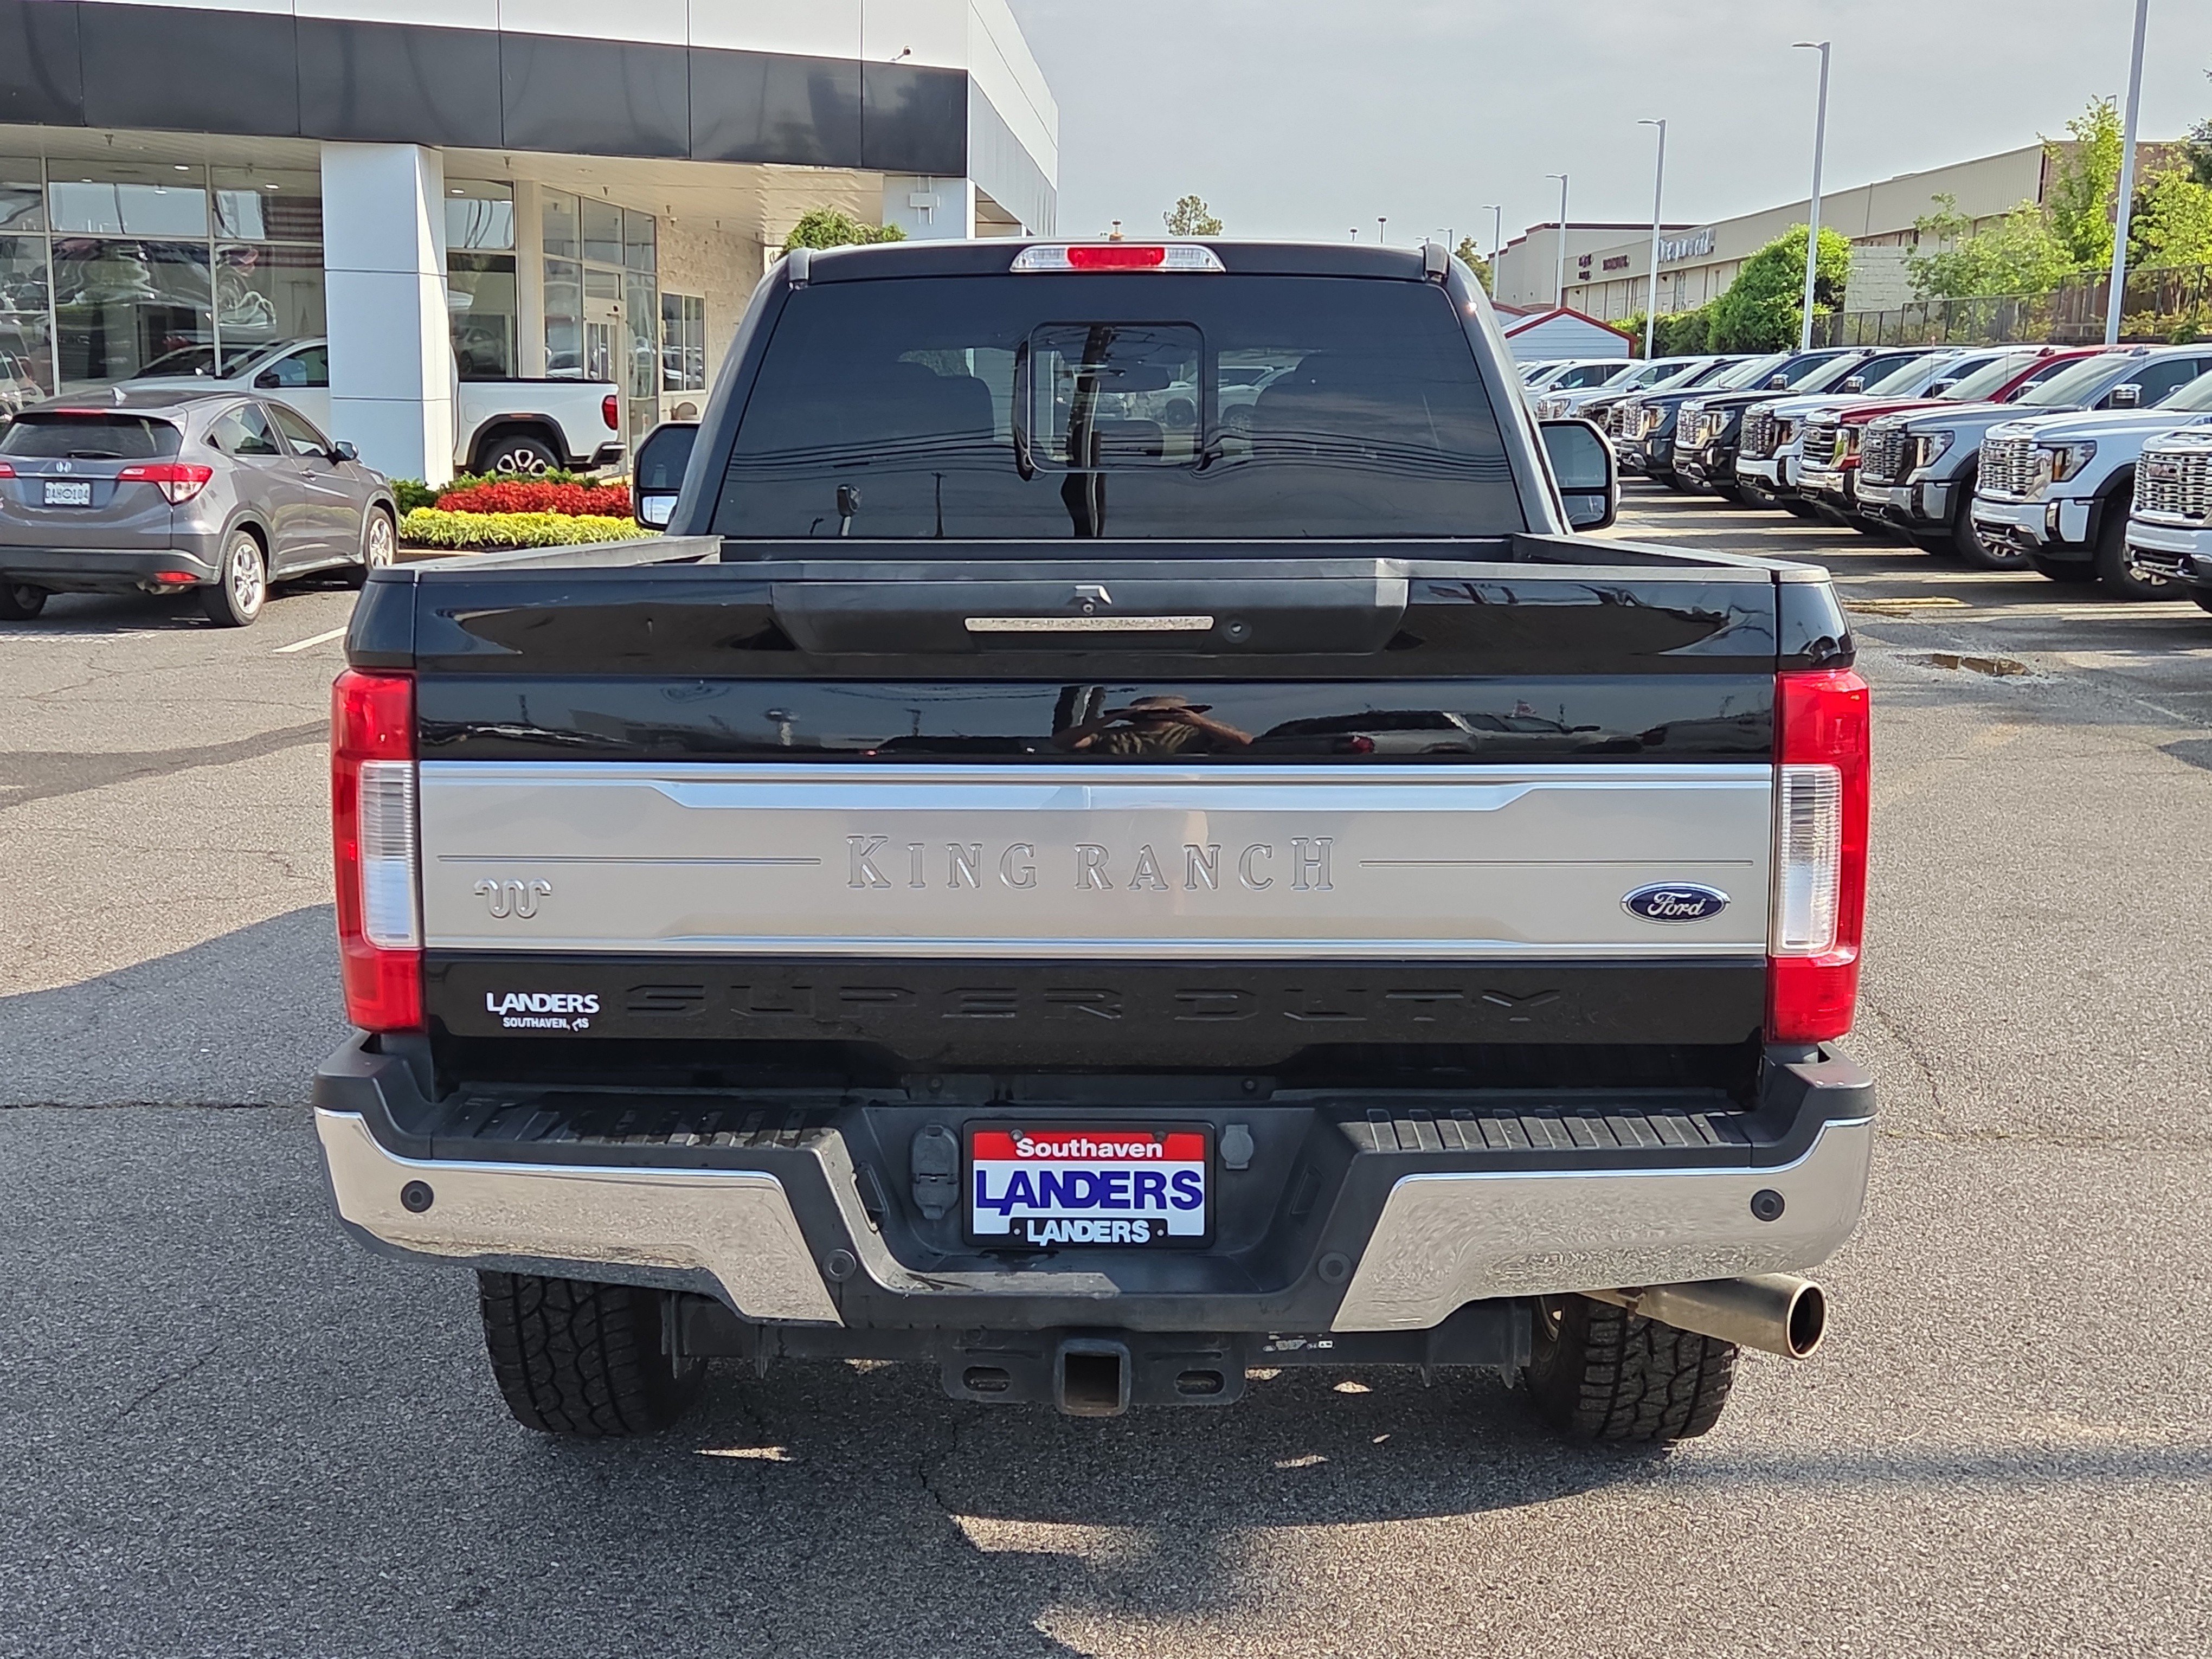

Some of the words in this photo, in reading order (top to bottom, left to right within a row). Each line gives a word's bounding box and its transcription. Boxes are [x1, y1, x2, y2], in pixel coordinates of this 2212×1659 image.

[846, 834, 1038, 890] KING
[1073, 835, 1335, 891] RANCH
[1647, 892, 1706, 916] Ford
[486, 992, 600, 1015] LANDERS
[626, 983, 1122, 1018] SUPER
[1174, 988, 1561, 1022] DUTY
[503, 1017, 570, 1030] SOUTHAVEN,
[1015, 1137, 1163, 1158] Southaven
[976, 1169, 1203, 1216] LANDERS
[1027, 1220, 1150, 1246] LANDERS
